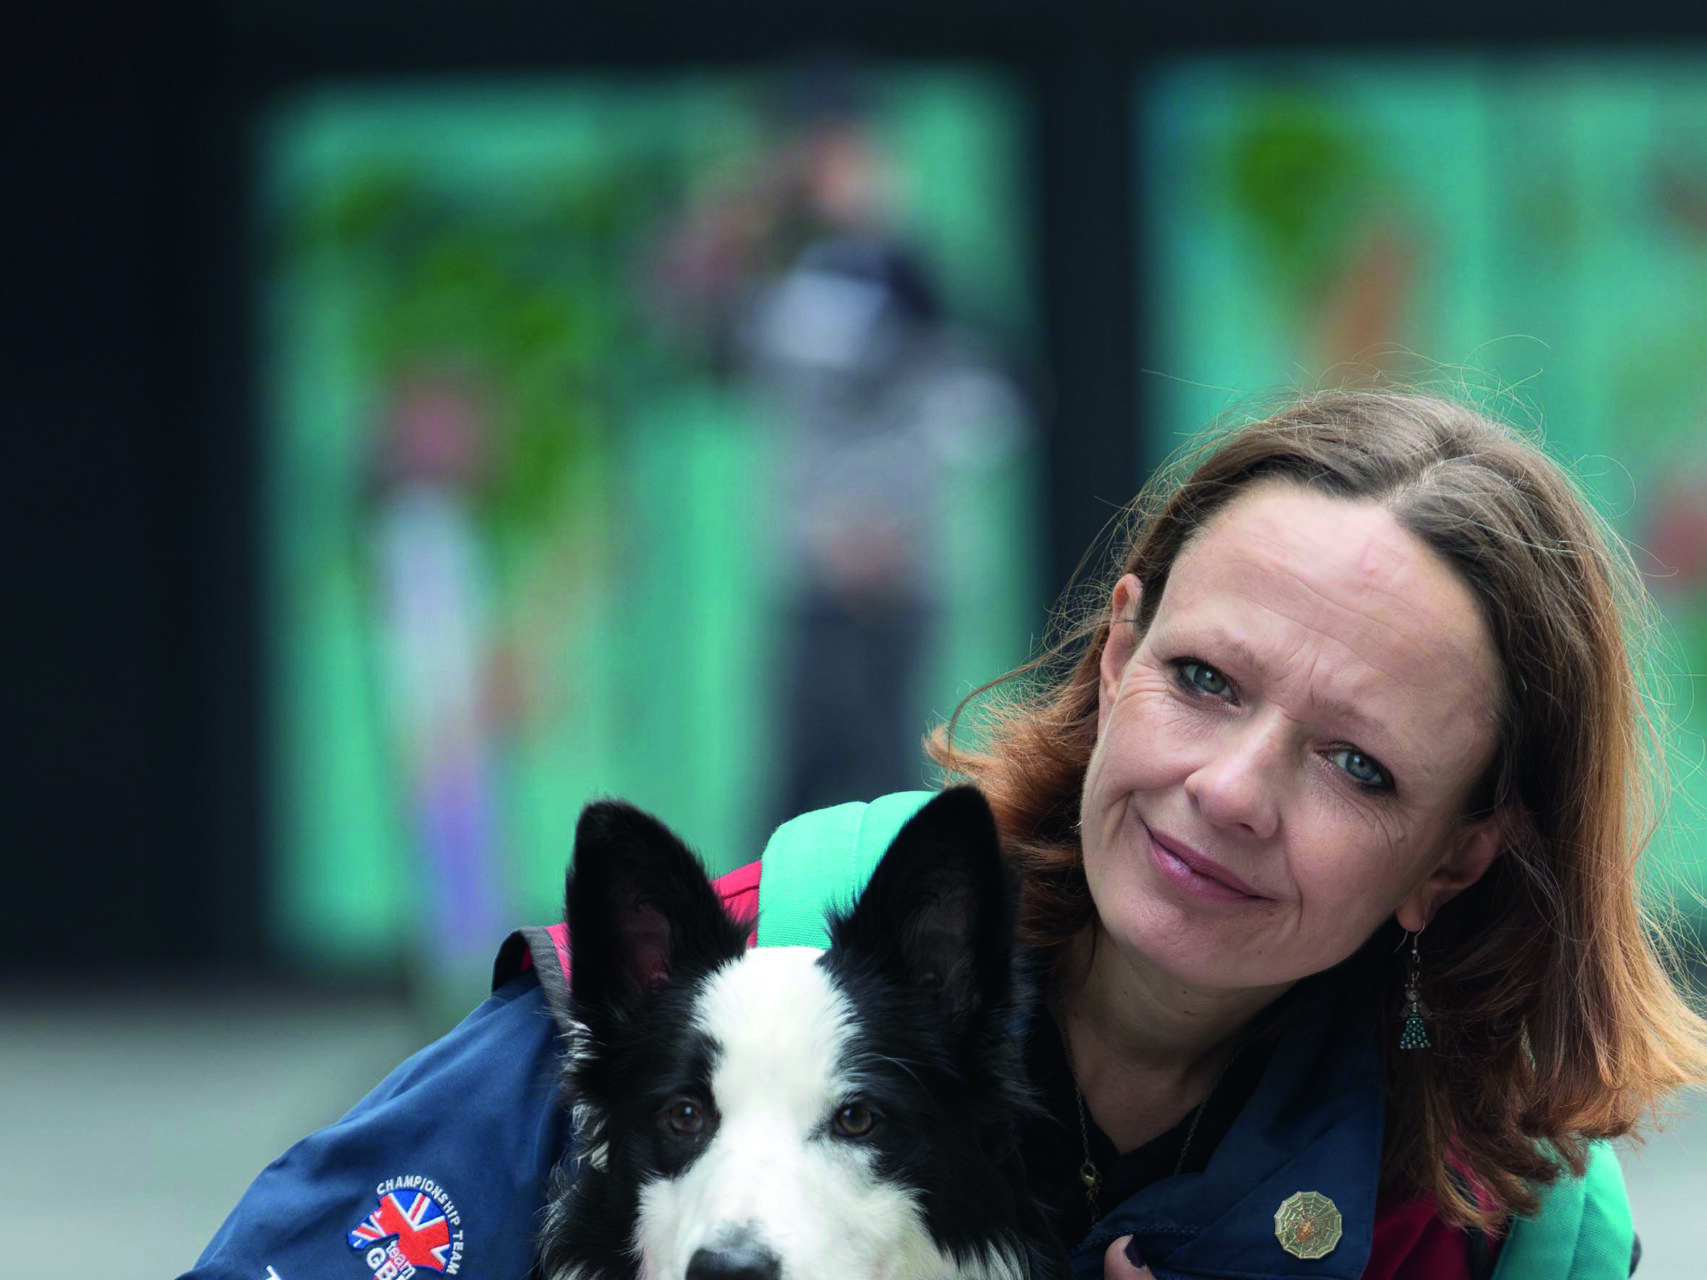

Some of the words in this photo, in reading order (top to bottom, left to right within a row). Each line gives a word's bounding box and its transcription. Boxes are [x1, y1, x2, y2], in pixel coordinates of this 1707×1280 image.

[377, 1175, 461, 1226] CHAMPIONSHIP
[446, 1230, 463, 1275] TEAM
[386, 1241, 416, 1278] team
